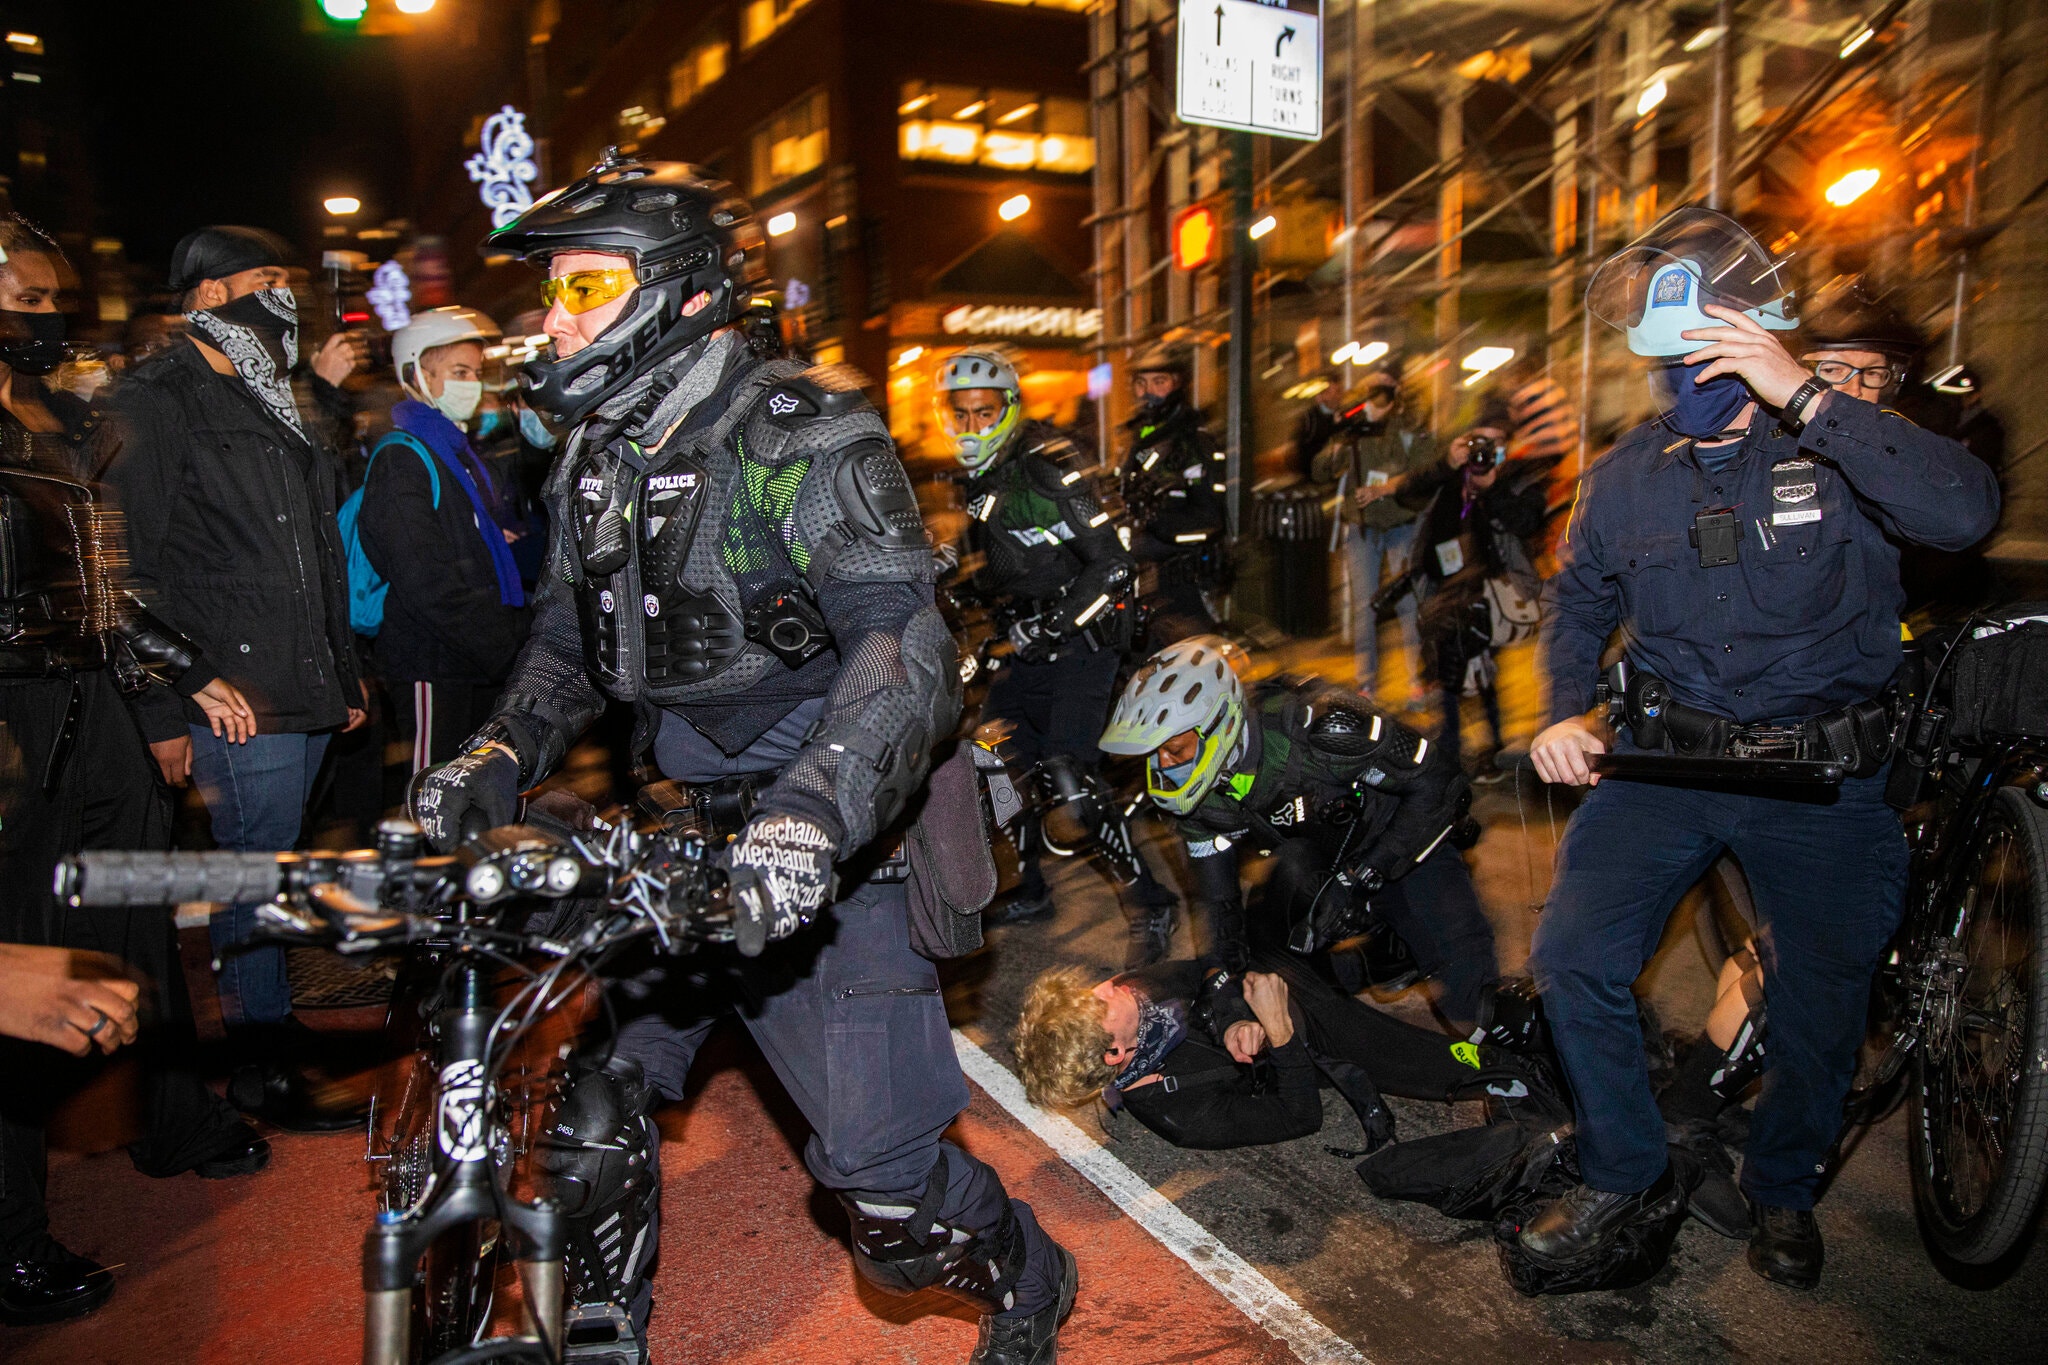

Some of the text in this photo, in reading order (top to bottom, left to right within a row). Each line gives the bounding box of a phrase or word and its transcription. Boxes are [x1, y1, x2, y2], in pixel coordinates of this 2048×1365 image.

[1271, 63, 1301, 82] RIGHT
[1269, 85, 1303, 105] TURNS
[1272, 107, 1298, 125] ONLY
[648, 474, 696, 490] POLICE
[1779, 511, 1816, 522] SULLIVAN
[556, 1123, 574, 1137] 2453
